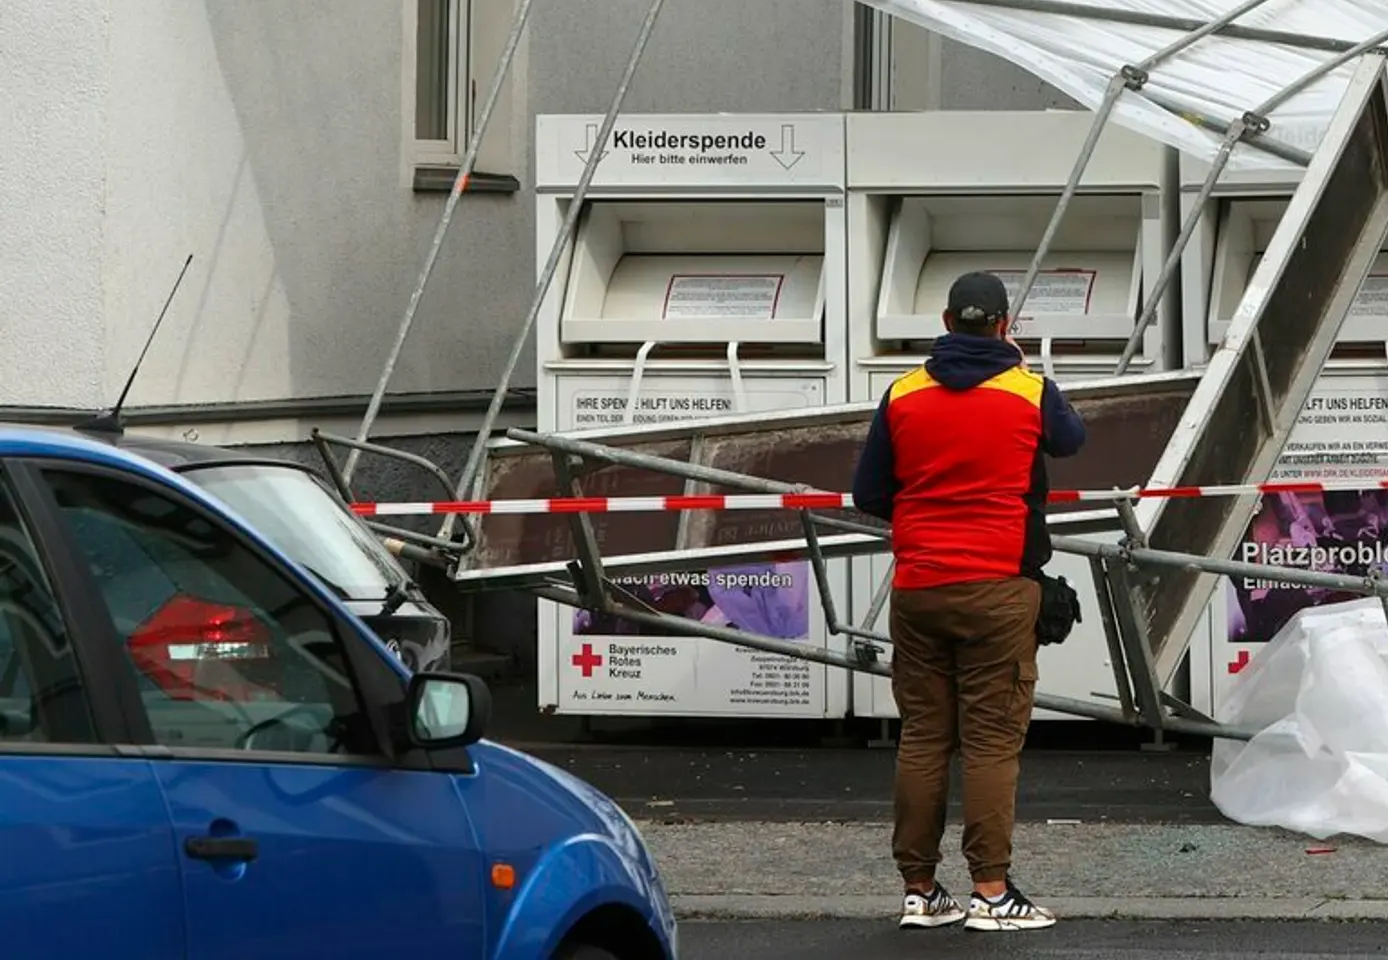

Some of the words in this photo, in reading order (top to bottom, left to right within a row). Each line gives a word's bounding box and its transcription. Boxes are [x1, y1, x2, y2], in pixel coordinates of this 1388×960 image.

[613, 130, 767, 153] Kleiderspende
[631, 154, 656, 165] Hier
[659, 154, 685, 165] bitte
[688, 154, 748, 165] einwerfen
[577, 397, 599, 410] IHRE
[601, 397, 639, 410] SPEN
[641, 397, 668, 410] HILFT
[670, 397, 690, 410] UNS
[692, 397, 732, 410] HELFEN!
[1305, 397, 1324, 410] LFT
[1326, 397, 1348, 410] UNS
[660, 572, 710, 586] etwas
[716, 571, 793, 589] spenden
[1243, 576, 1313, 589] Einac
[608, 643, 678, 656] Bayerisches
[608, 656, 642, 667] Rotes
[608, 668, 642, 679] Kreuz
